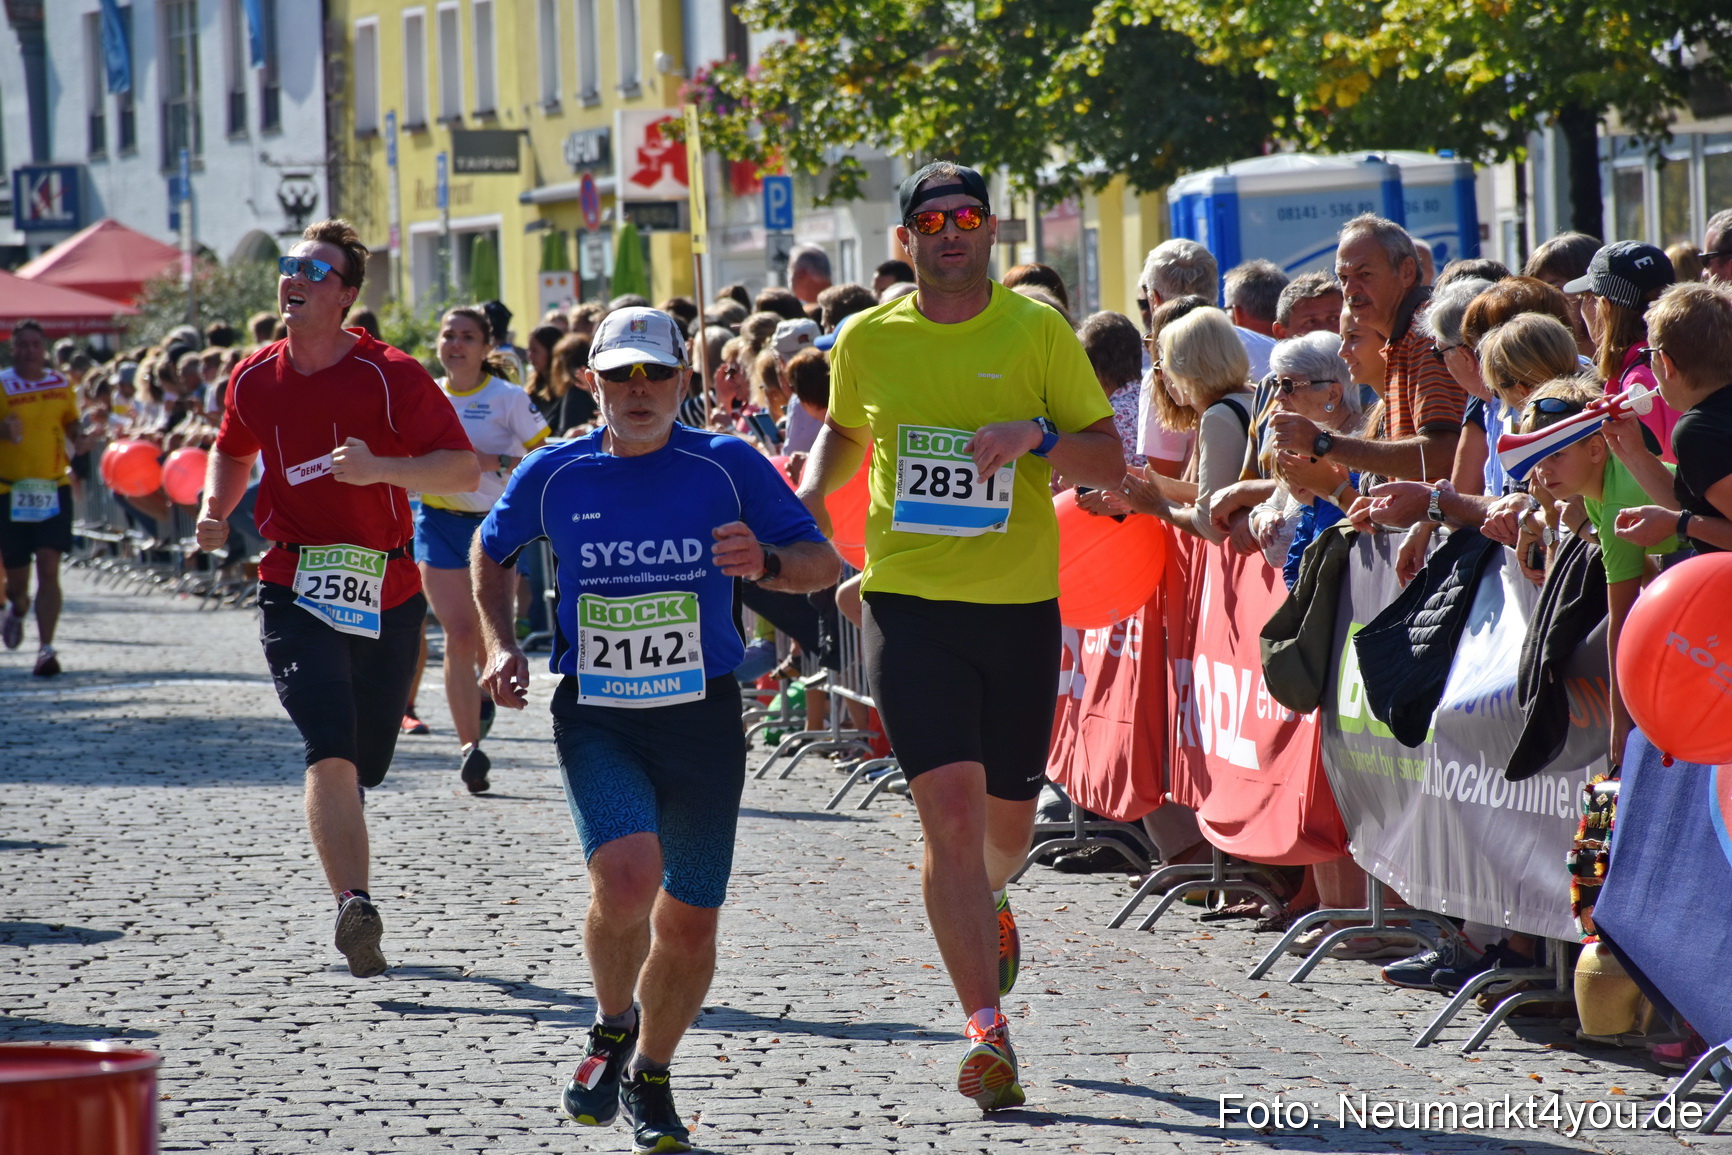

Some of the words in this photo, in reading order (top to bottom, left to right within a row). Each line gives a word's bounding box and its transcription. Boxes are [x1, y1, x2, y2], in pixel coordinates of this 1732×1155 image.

[457, 156, 517, 170] TAIFUN
[768, 181, 788, 225] P
[1277, 206, 1317, 222] 08141
[1329, 202, 1353, 218] 536
[906, 430, 975, 460] BOC
[300, 463, 322, 478] DEHN
[582, 512, 601, 520] JAKO
[305, 547, 380, 574] BOCK
[580, 538, 703, 568] SYSCAD
[303, 574, 372, 607] 2584
[579, 568, 707, 586] www.metallbau-cad.de
[586, 596, 689, 628] BOCK
[593, 631, 687, 671] 2142
[601, 677, 681, 696] JOHANN
